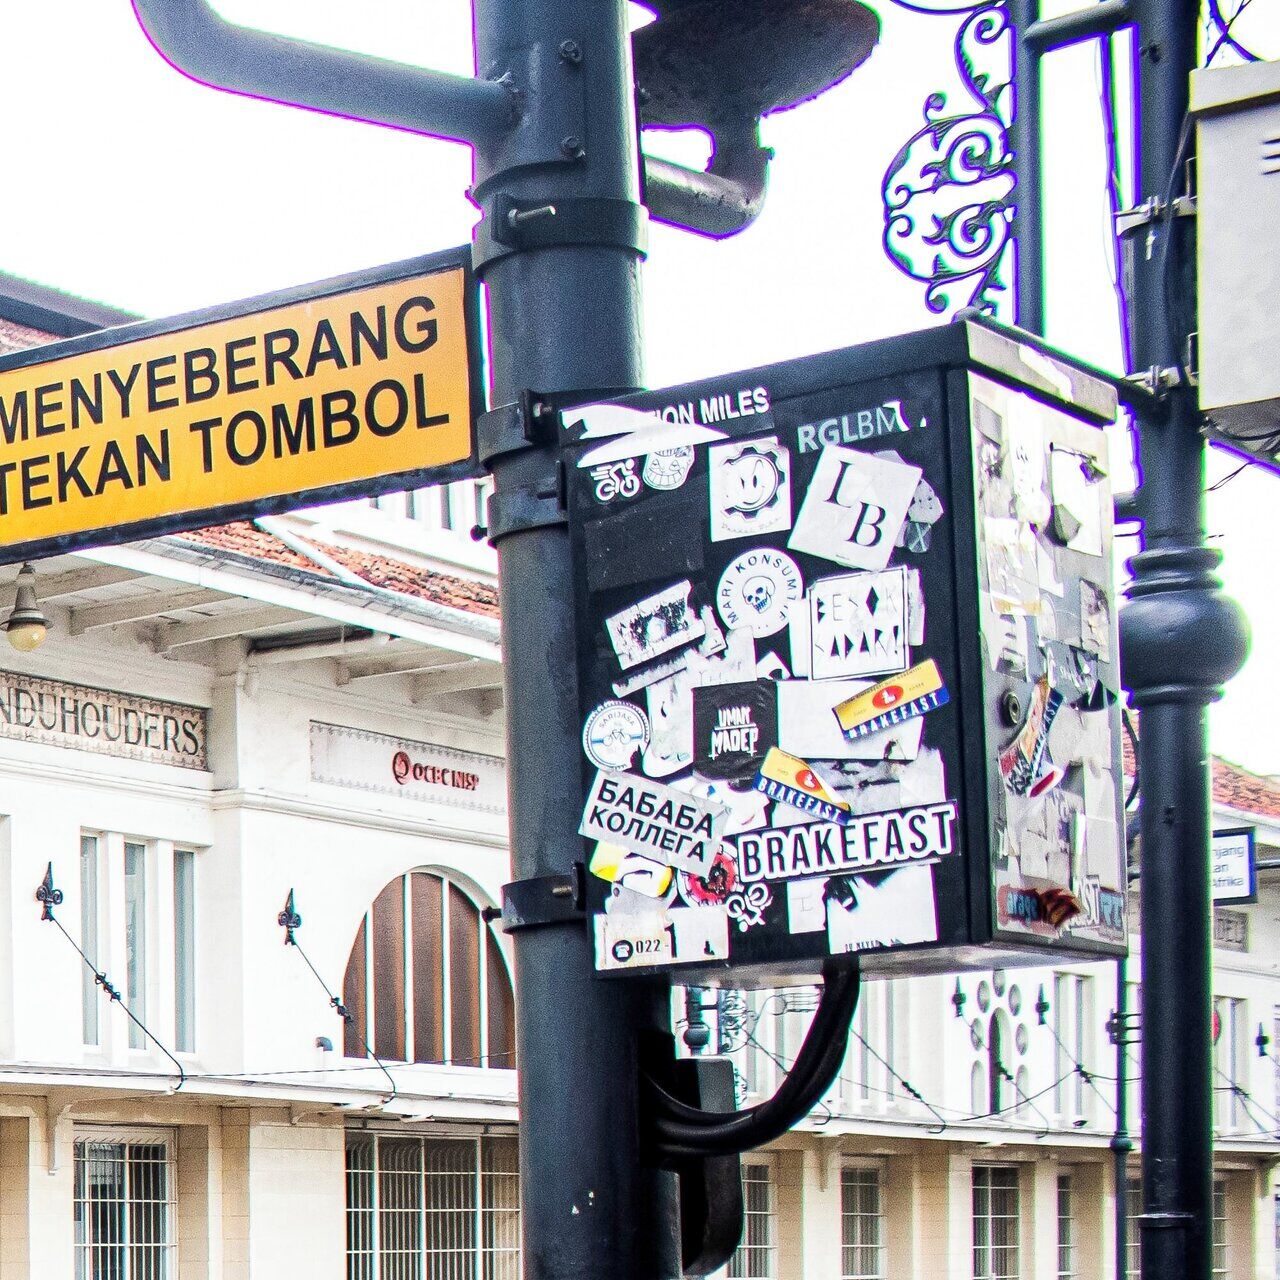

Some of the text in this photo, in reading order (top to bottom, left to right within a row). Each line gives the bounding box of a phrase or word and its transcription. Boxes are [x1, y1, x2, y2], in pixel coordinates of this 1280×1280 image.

[189, 373, 450, 473] TOMBOL
[700, 387, 770, 423] MILES
[597, 779, 714, 839] БАБАБА
[757, 777, 842, 820] BRAKEFAST
[589, 805, 706, 862] КОЛЛЕГА
[740, 809, 953, 879] BRAKEFAST
